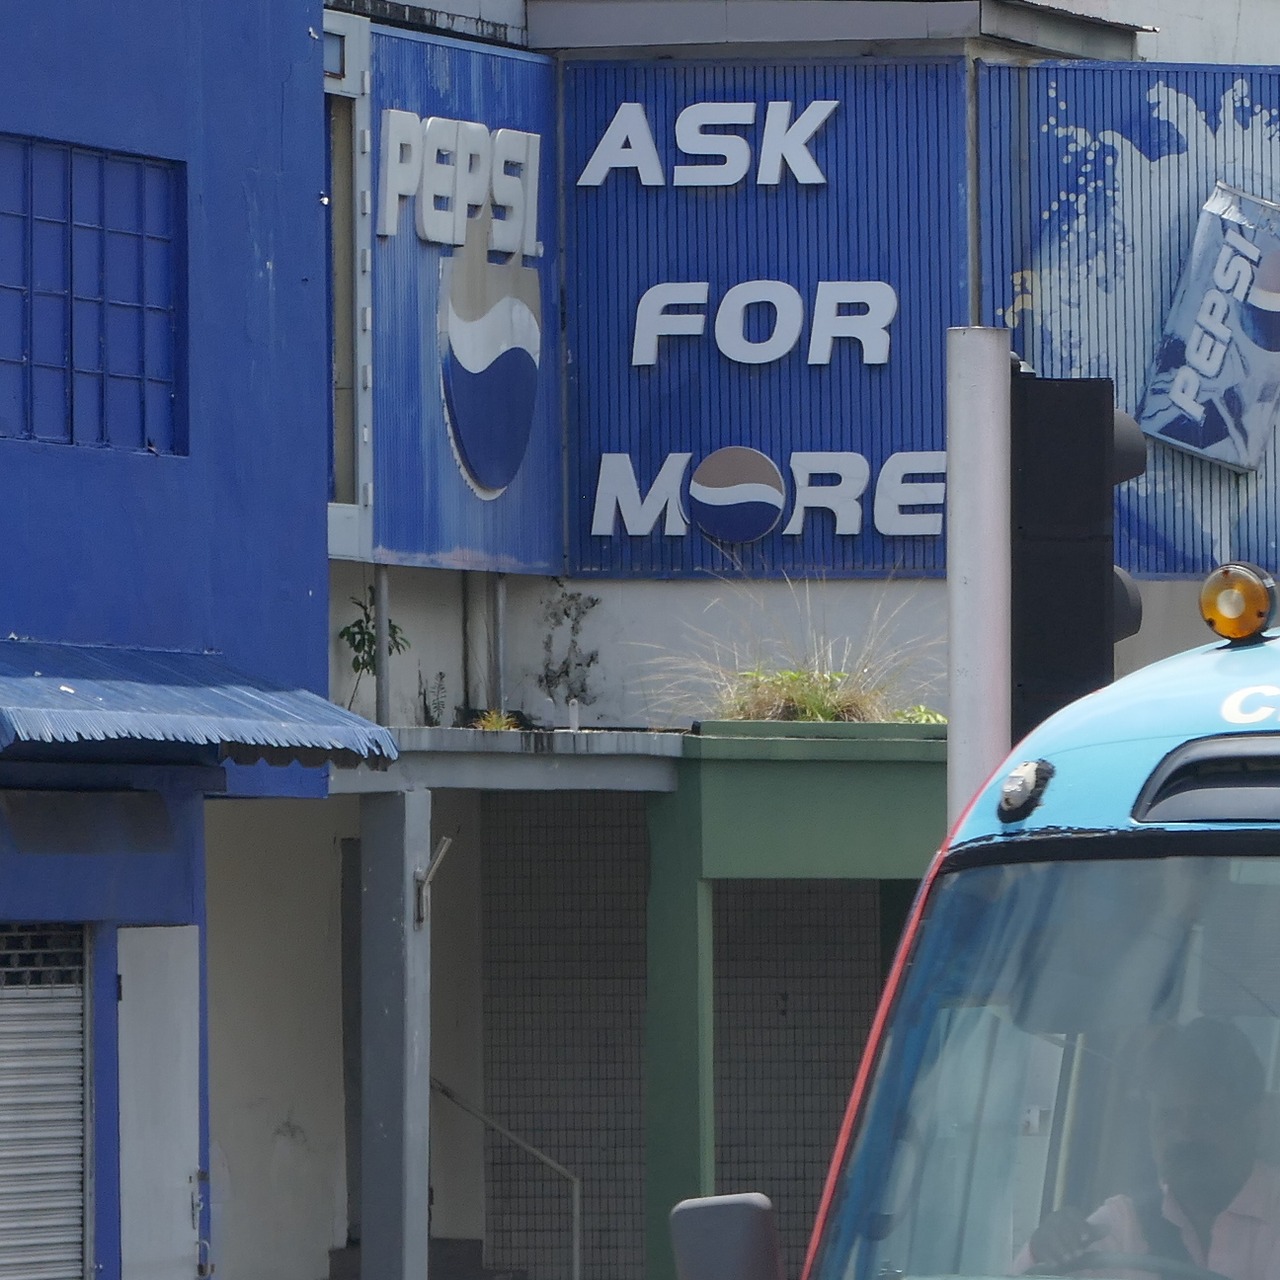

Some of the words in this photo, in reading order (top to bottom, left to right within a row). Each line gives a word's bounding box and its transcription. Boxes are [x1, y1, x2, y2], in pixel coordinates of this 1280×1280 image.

[376, 109, 543, 258] PEPSI
[577, 100, 839, 187] ASK
[631, 279, 899, 367] FOR
[1168, 228, 1263, 425] PEPSI
